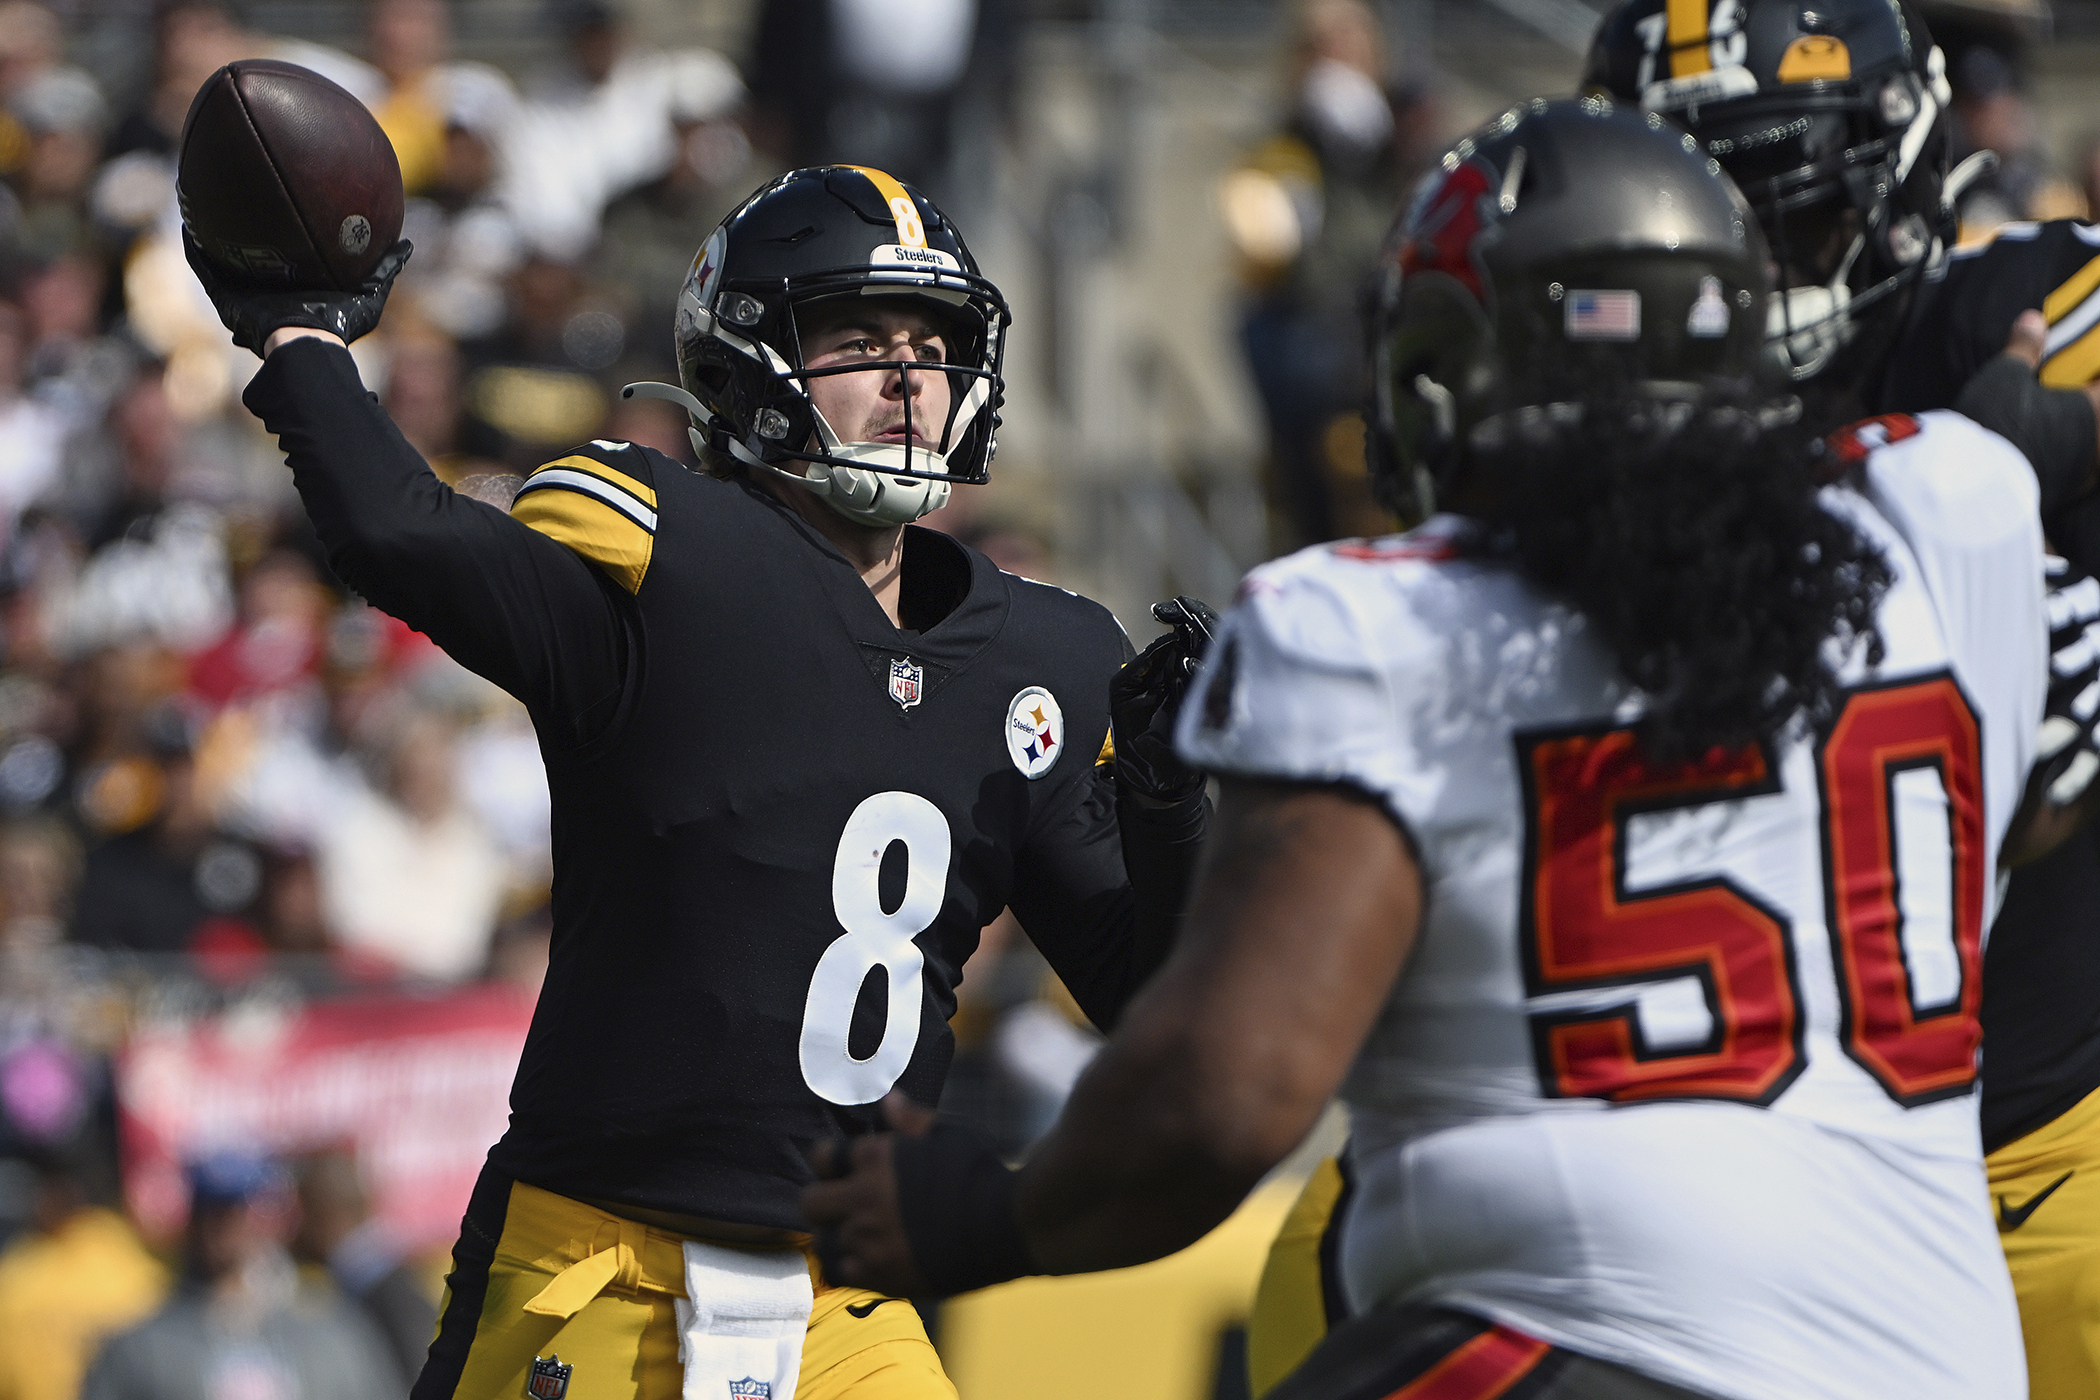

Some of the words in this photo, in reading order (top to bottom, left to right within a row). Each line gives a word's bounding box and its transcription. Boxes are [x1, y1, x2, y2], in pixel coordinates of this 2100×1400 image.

[890, 197, 924, 246] 8
[894, 247, 944, 265] Steelers
[895, 680, 918, 699] NFL
[1013, 717, 1036, 737] Steelers
[1514, 667, 1983, 1109] 50
[799, 791, 951, 1106] 8
[534, 1375, 560, 1396] NFL
